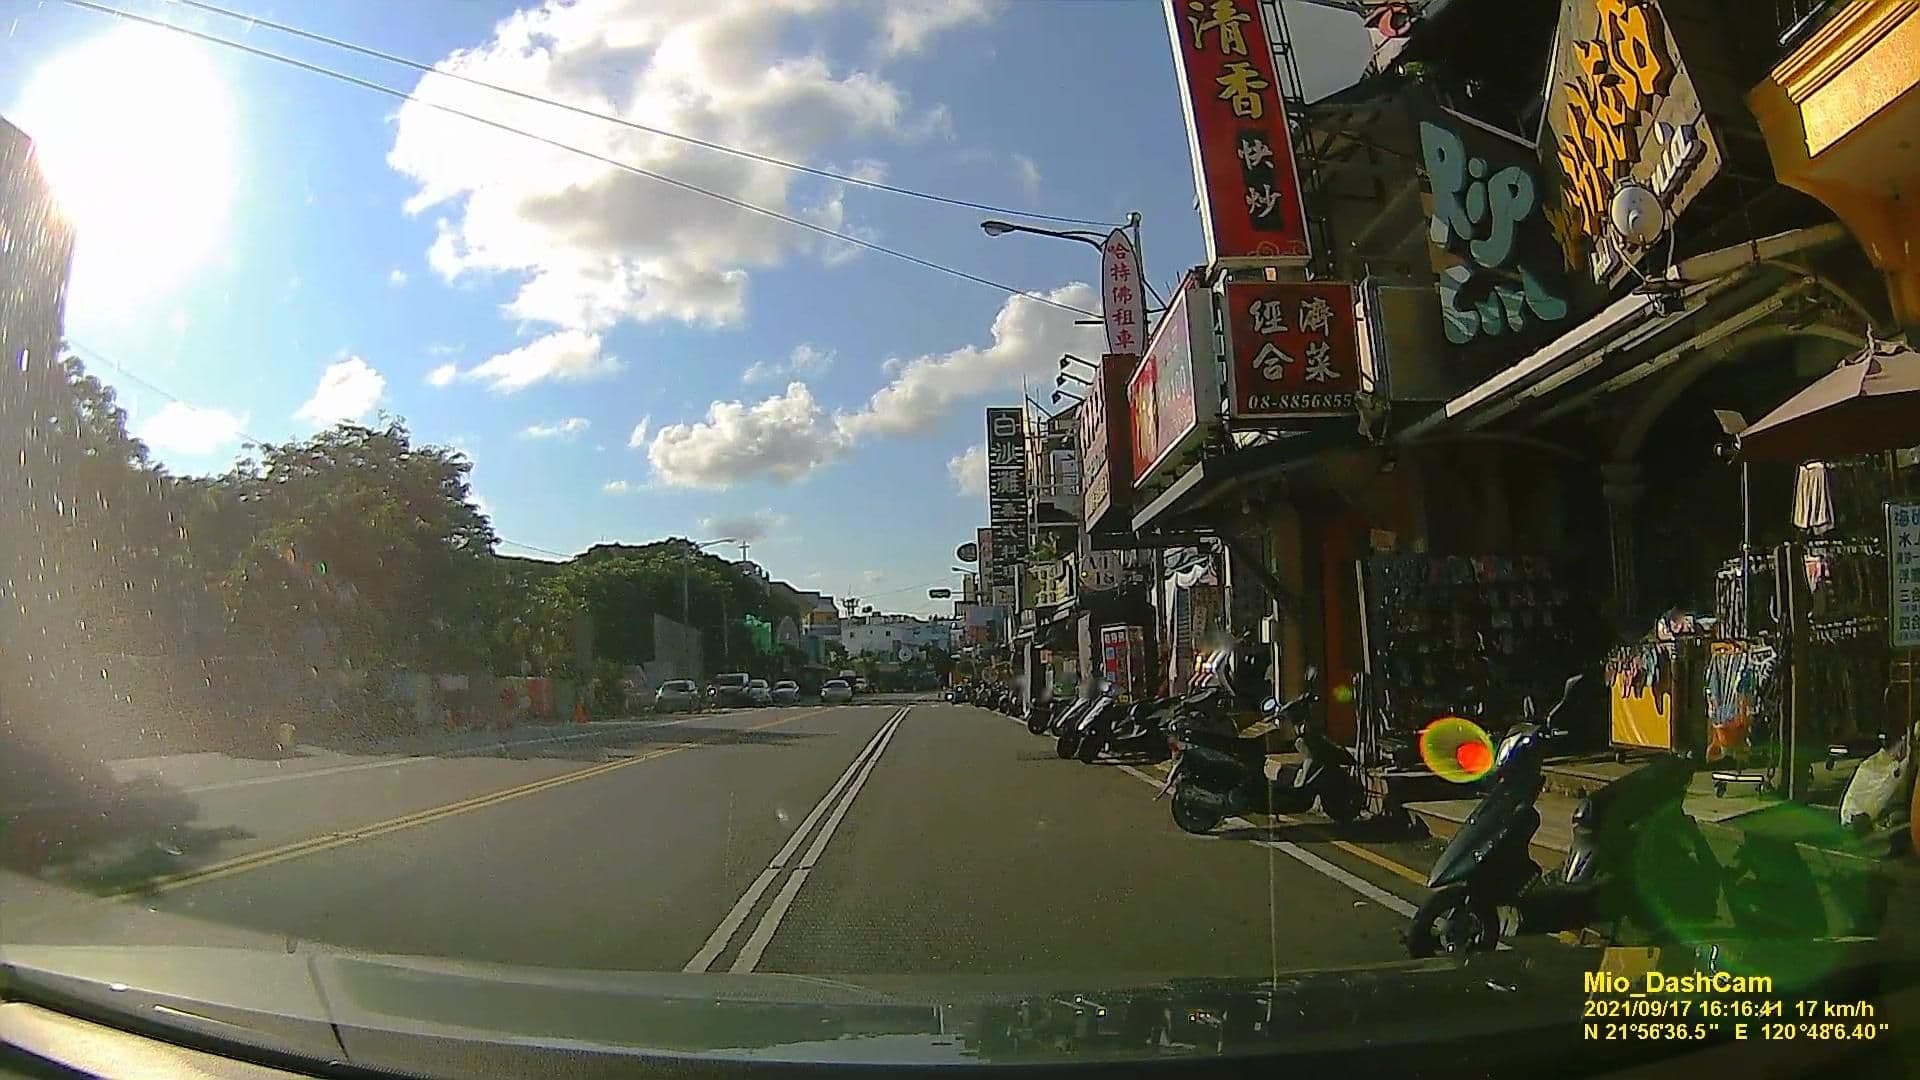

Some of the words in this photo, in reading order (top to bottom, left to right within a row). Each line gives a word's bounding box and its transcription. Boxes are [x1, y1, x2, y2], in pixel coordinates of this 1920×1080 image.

[1237, 138, 1282, 219] 快炒
[1420, 121, 1534, 268] Rip
[1107, 243, 1135, 349] 哈特佛租車
[1248, 296, 1335, 337] 經濟
[1252, 341, 1341, 383] 合菜
[1248, 392, 1355, 411] 08-8856855
